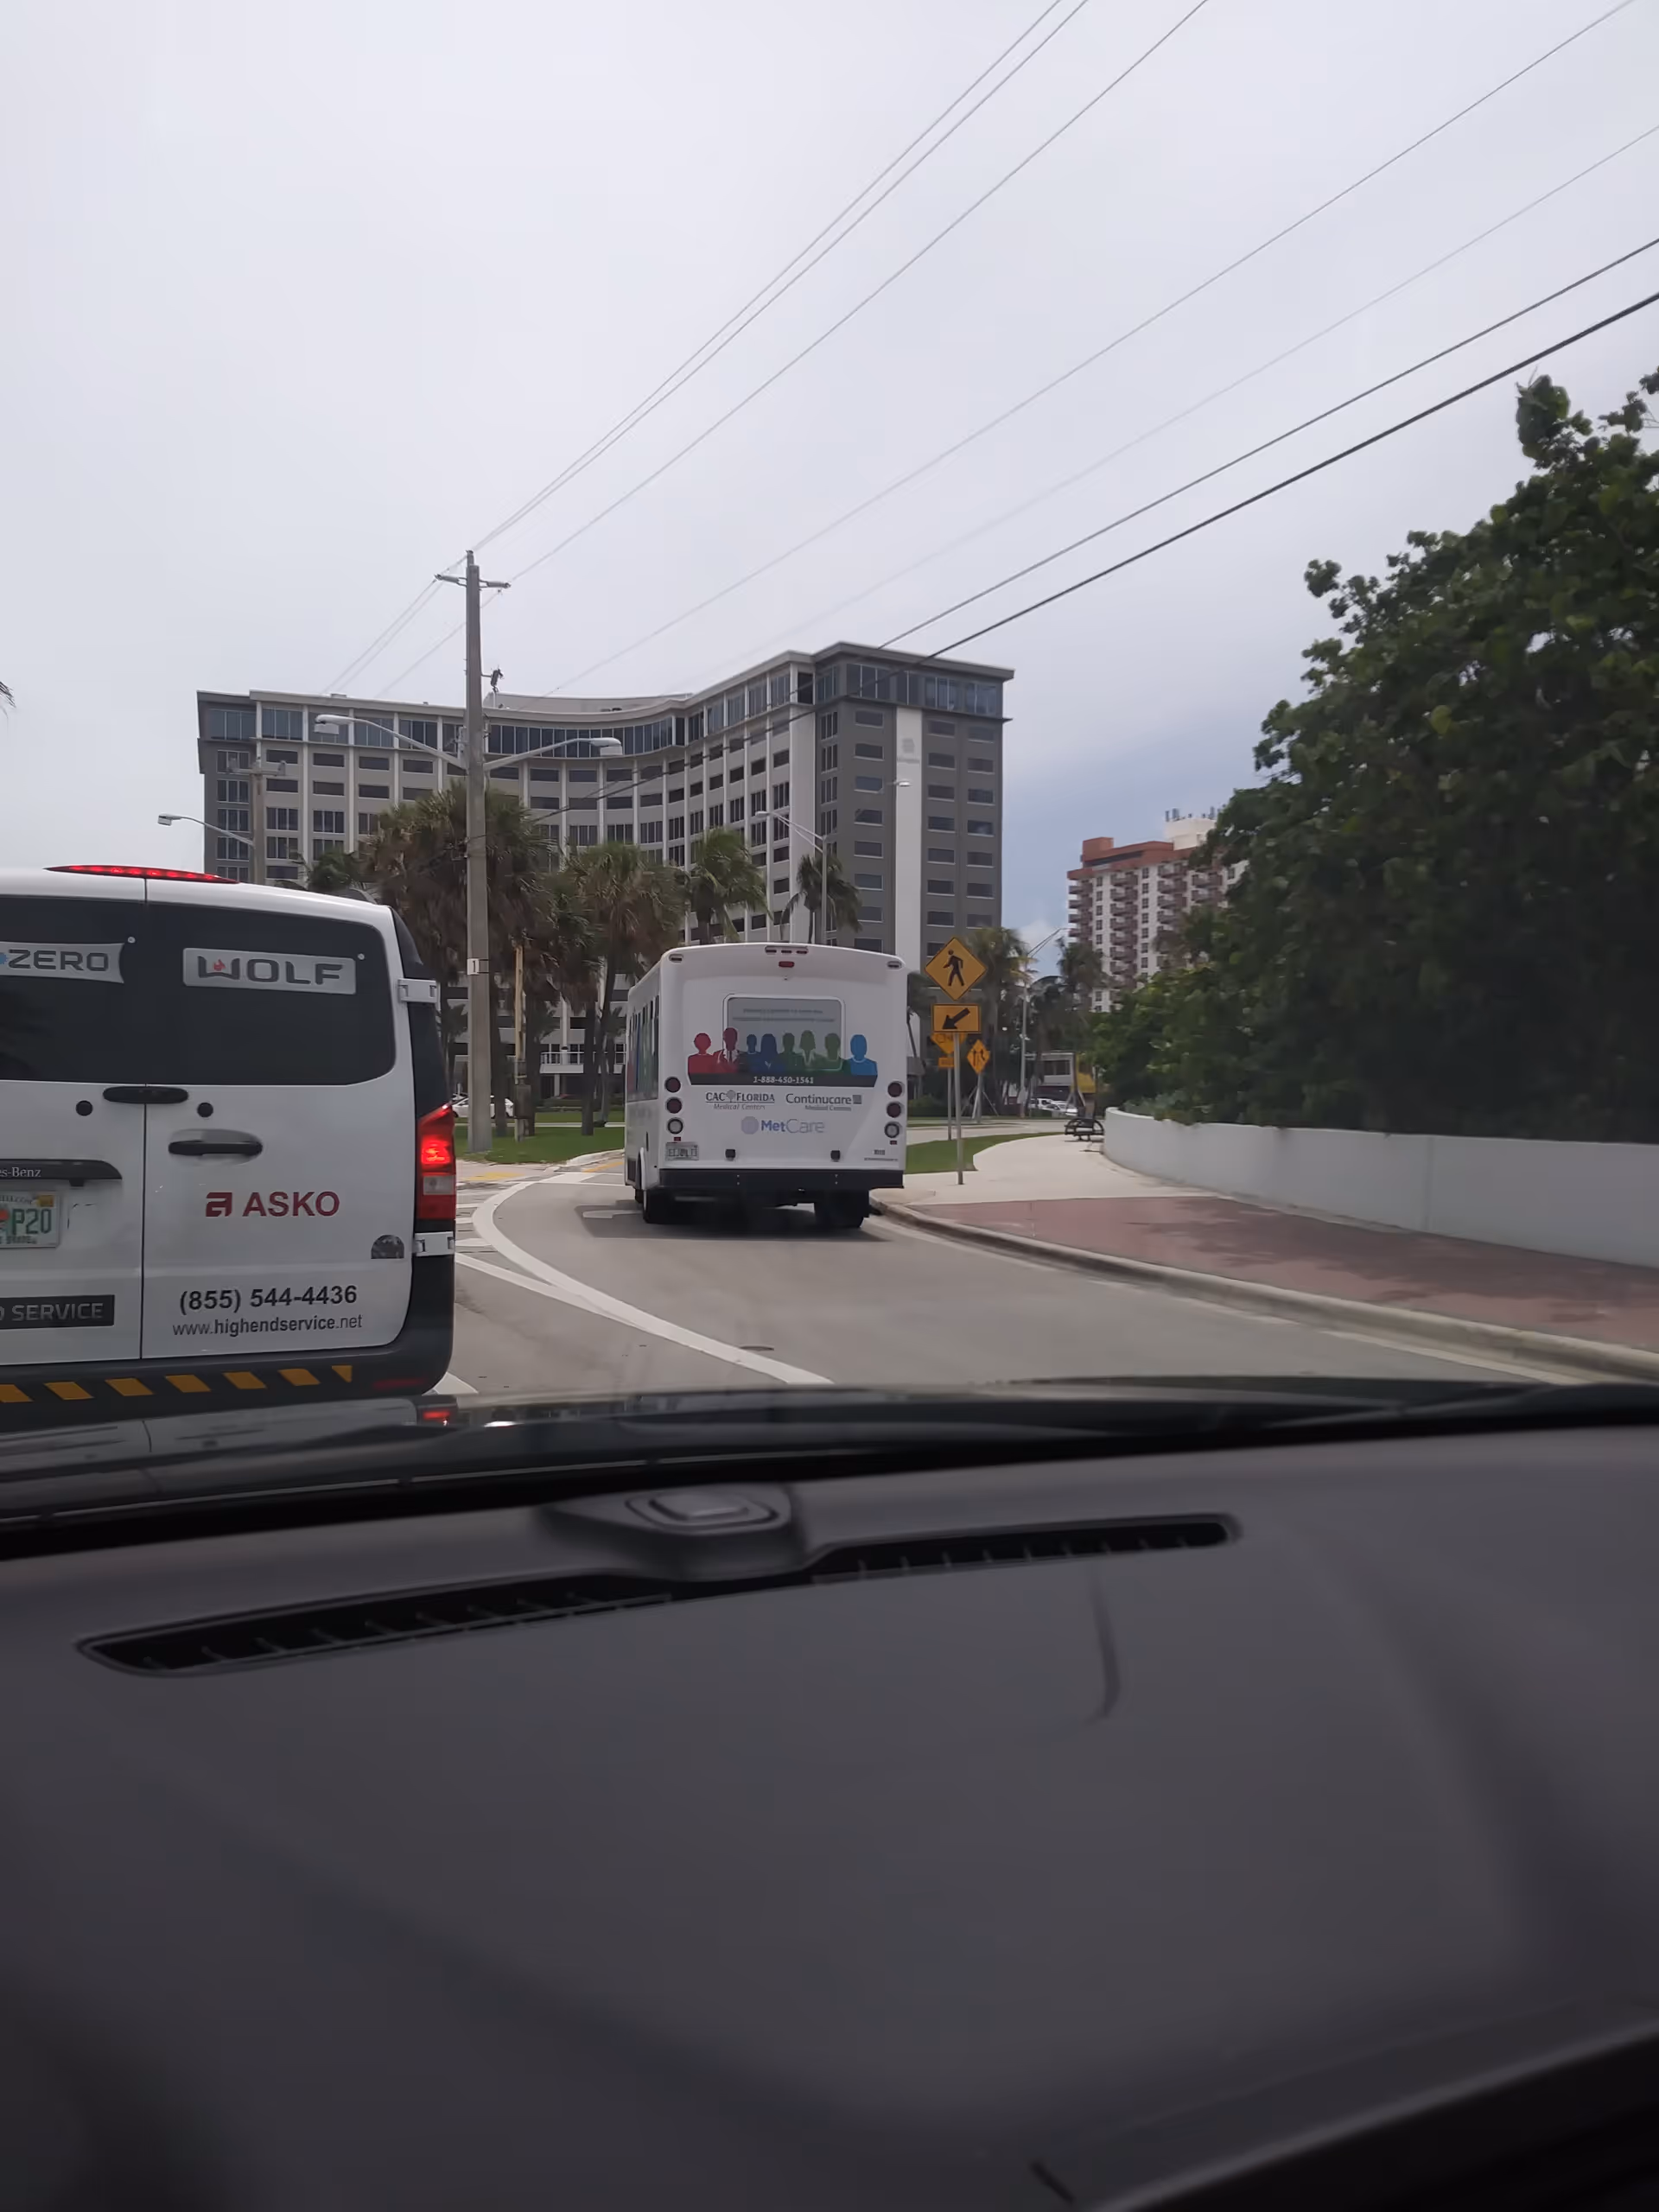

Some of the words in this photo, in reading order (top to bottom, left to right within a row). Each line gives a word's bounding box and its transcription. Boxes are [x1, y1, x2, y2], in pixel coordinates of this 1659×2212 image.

[8, 949, 109, 971] ZERO
[197, 955, 343, 985] WOLF
[705, 1091, 726, 1102] CAC
[736, 1092, 775, 1102] FLORIDA
[785, 1093, 852, 1104] Continucare
[761, 1118, 825, 1134] MetCare
[242, 1191, 340, 1217] ASKO
[180, 1289, 241, 1316] (855)
[250, 1285, 358, 1307] 544-4436
[11, 1302, 104, 1322] SERVICE
[172, 1314, 363, 1338] www.highendservice.net
